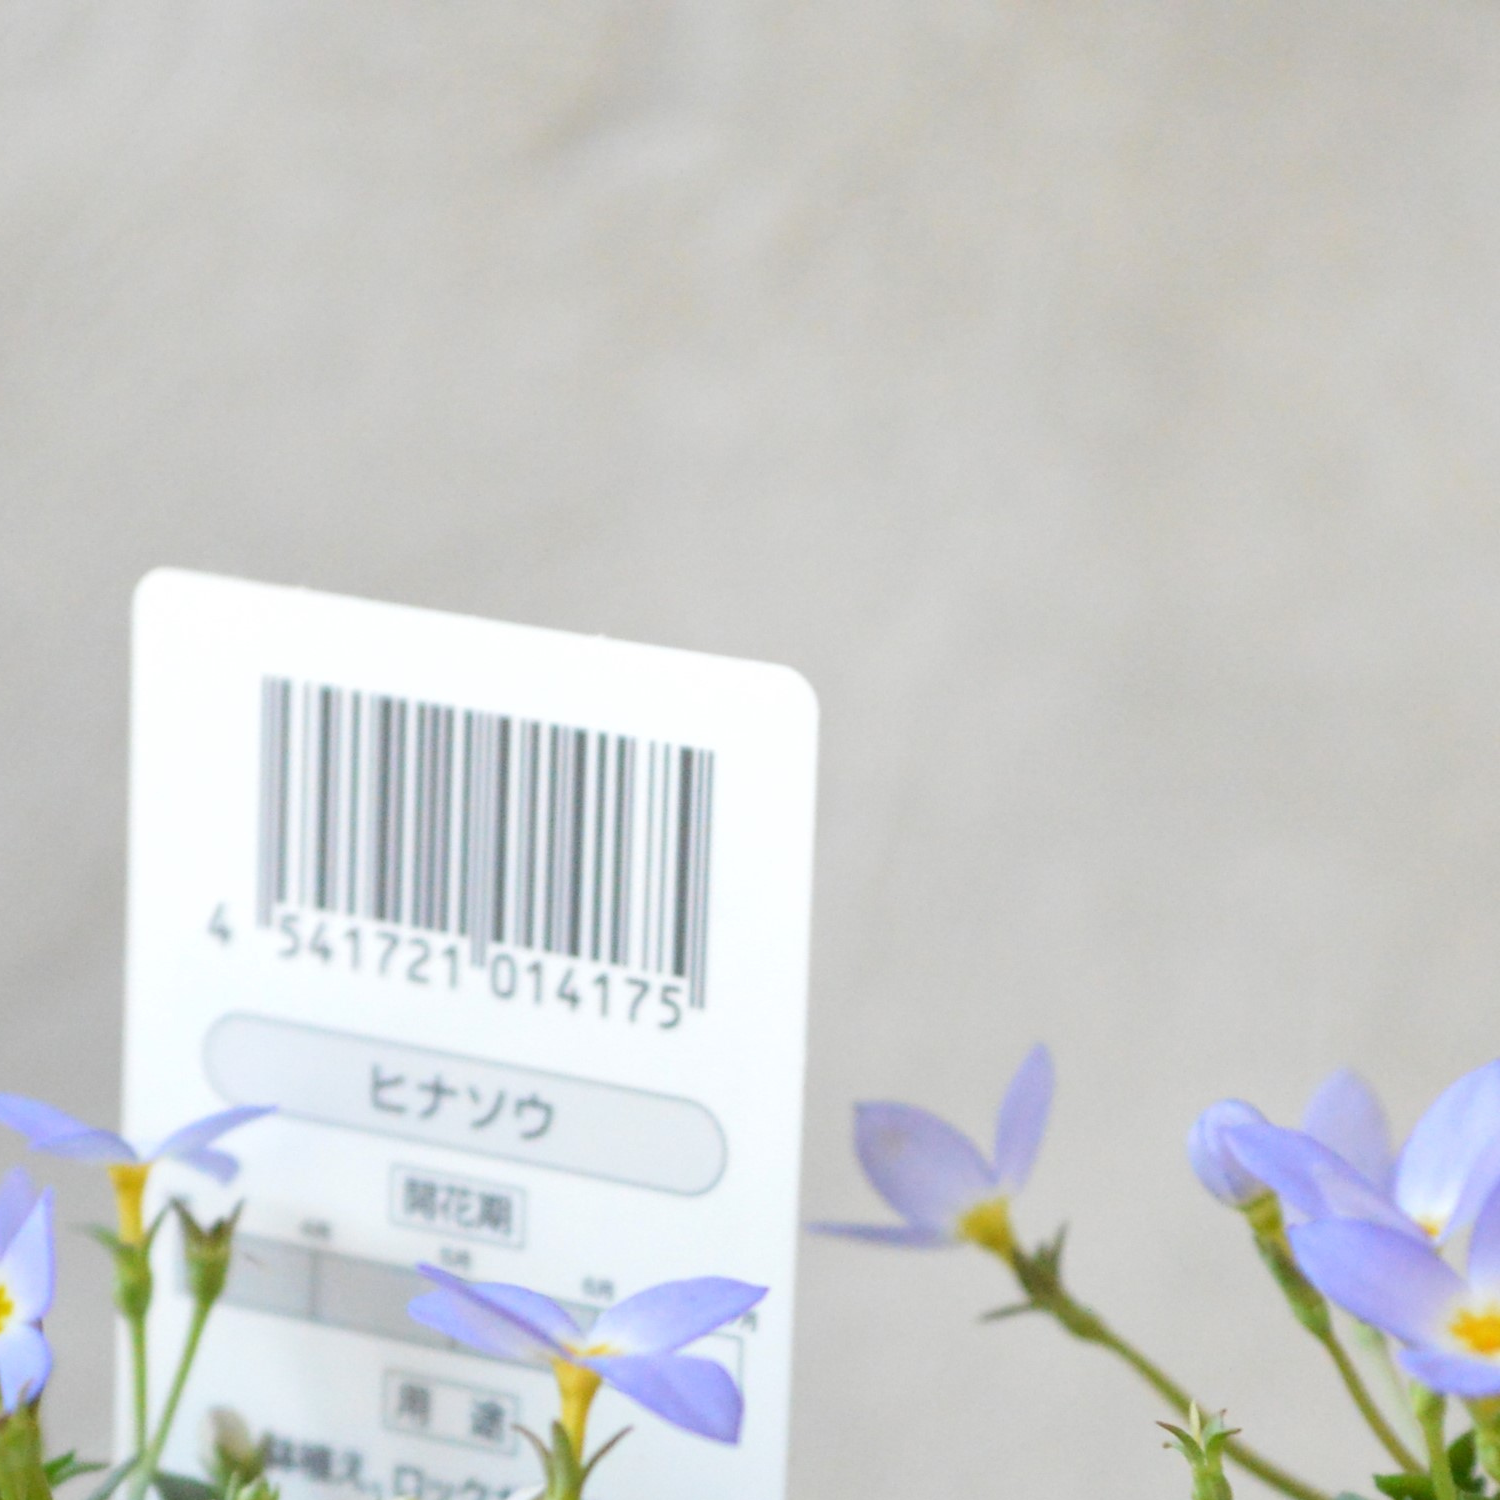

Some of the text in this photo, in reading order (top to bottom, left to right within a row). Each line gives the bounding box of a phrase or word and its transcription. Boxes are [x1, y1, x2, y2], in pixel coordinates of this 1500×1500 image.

[208, 903, 684, 1030] 4 541721 014175
[369, 1063, 555, 1140] ヒナソウ
[405, 1178, 512, 1237] 開花期
